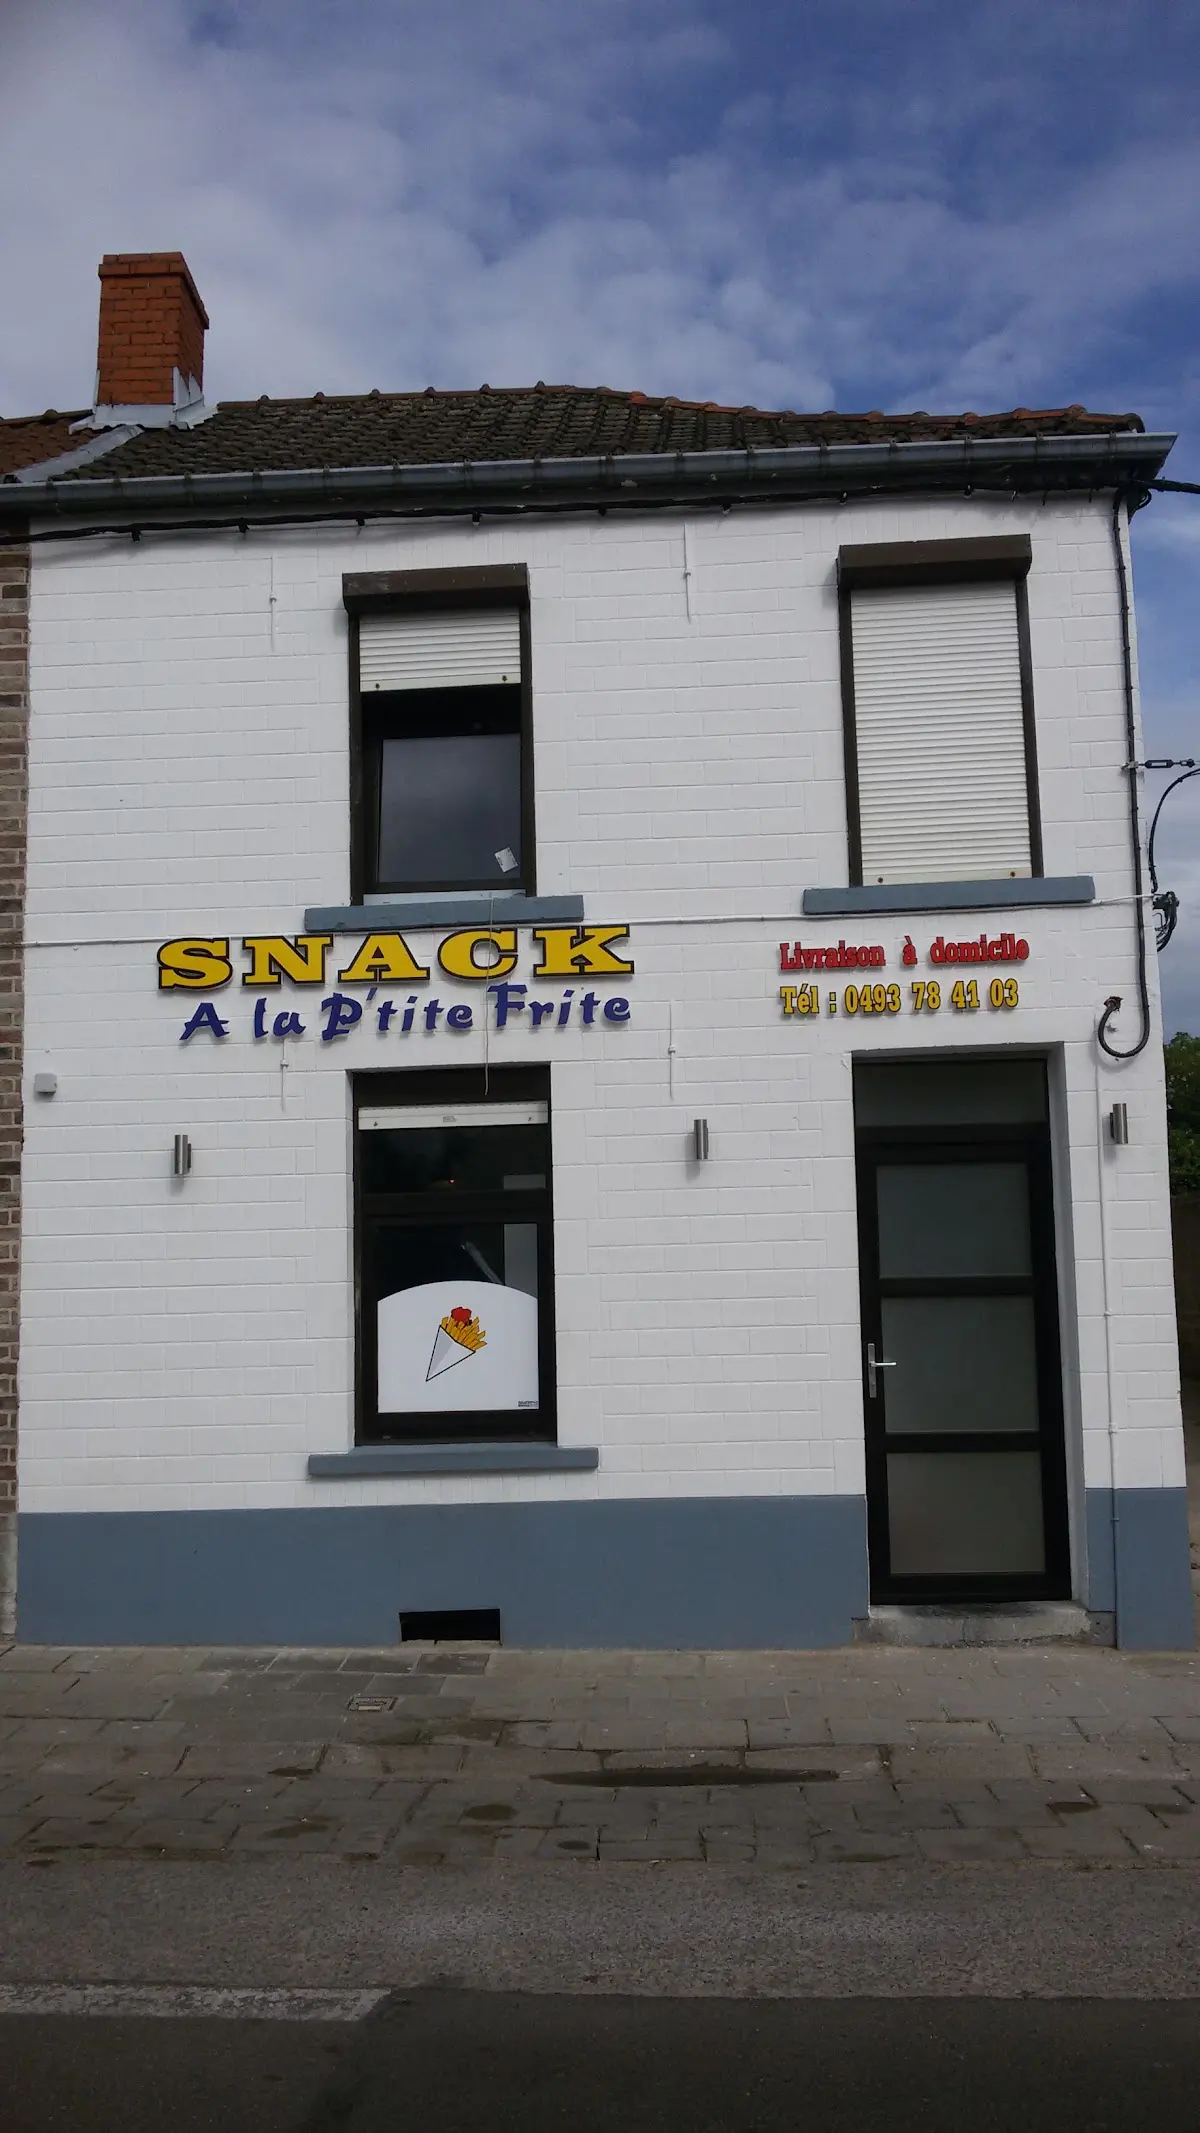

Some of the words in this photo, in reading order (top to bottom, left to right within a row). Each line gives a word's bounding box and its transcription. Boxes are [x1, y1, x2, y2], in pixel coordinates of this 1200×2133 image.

[157, 924, 635, 990] SNACK
[780, 940, 886, 969] Livraison
[902, 935, 918, 965] à
[930, 933, 1030, 963] domicile
[180, 1002, 229, 1041] A
[254, 998, 306, 1037] la
[321, 987, 474, 1041] P'tite
[487, 981, 632, 1028] Frite
[780, 983, 819, 1014] Tél
[844, 984, 901, 1014] 0493
[912, 980, 941, 1010] 78
[952, 979, 980, 1009] 41
[990, 978, 1019, 1008] 03
